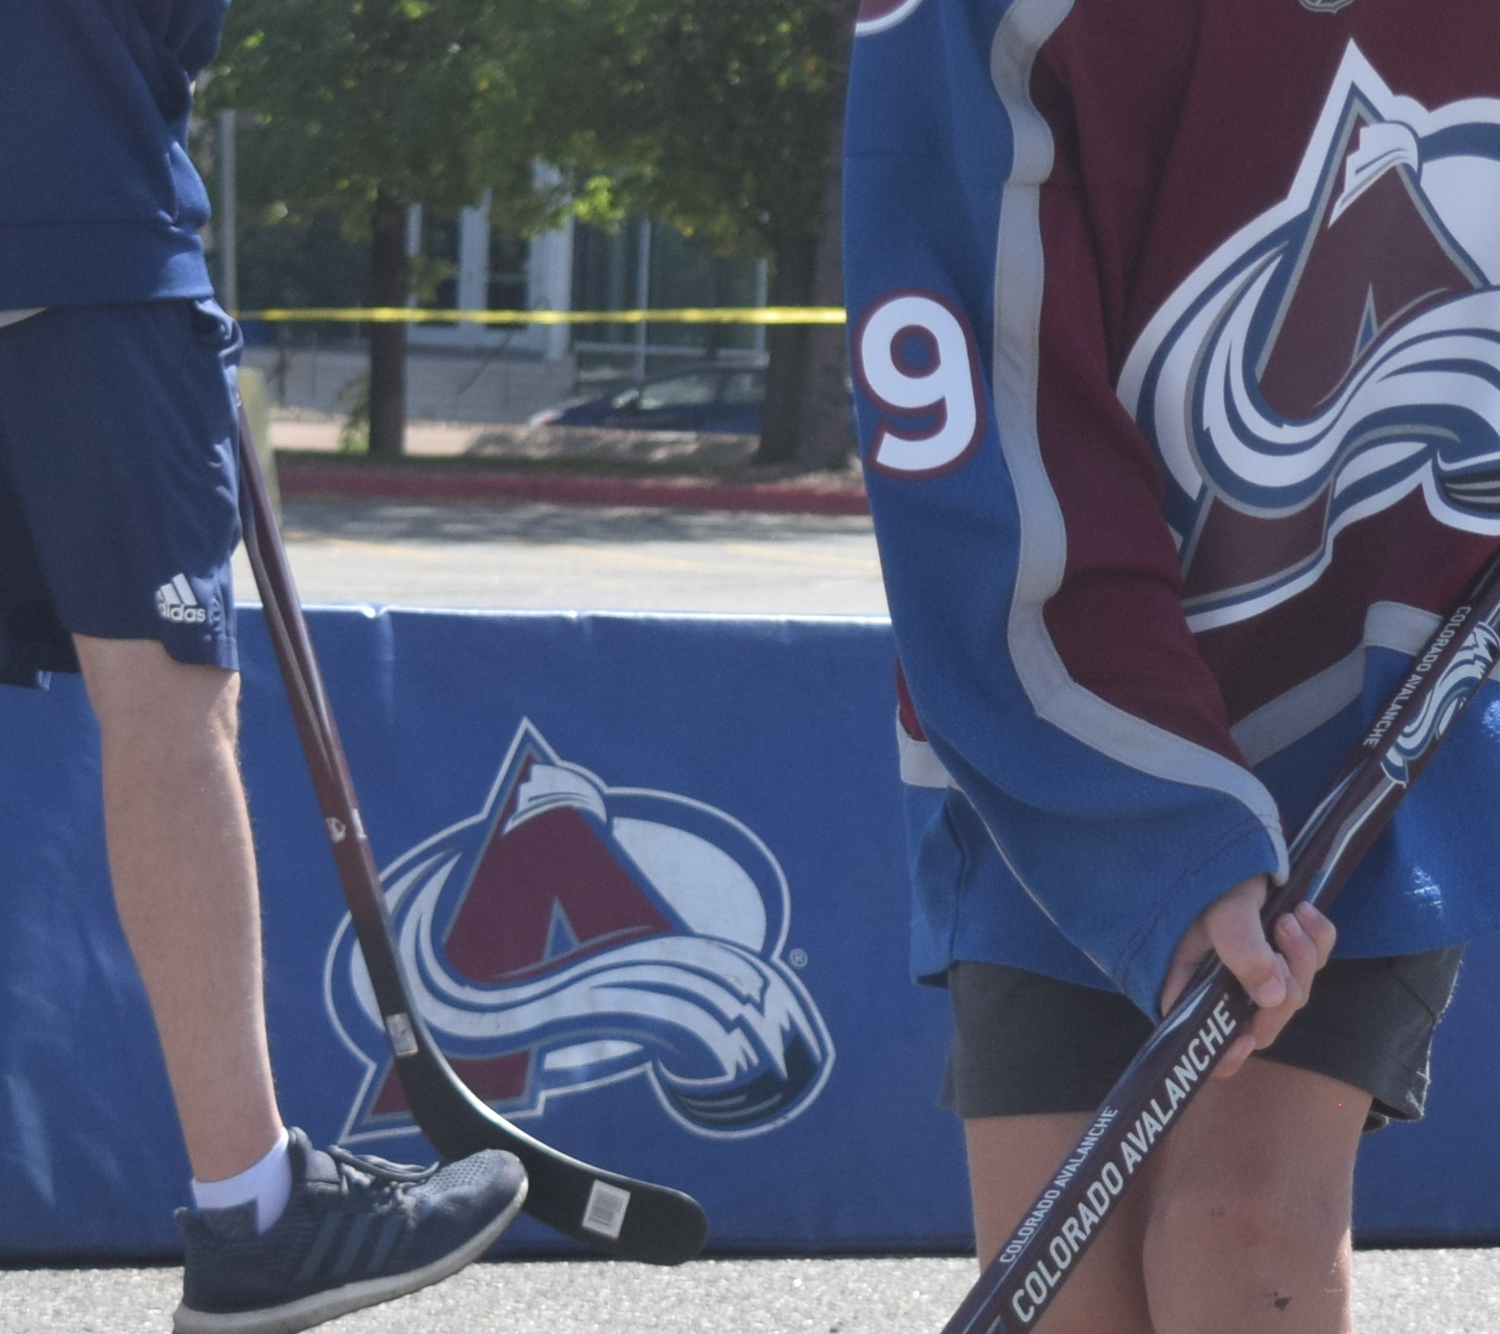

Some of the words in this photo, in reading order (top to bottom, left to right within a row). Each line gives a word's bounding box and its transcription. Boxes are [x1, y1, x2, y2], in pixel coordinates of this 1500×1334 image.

[856, 291, 982, 475] 9
[1363, 674, 1422, 747] AVALANCHE
[1416, 606, 1471, 672] COLORADO
[1000, 1189, 1061, 1263] COLORADO
[1054, 1106, 1119, 1187] AVALANCHE
[1012, 1161, 1124, 1323] COLORADO
[1120, 999, 1236, 1174] AVALANCHE
